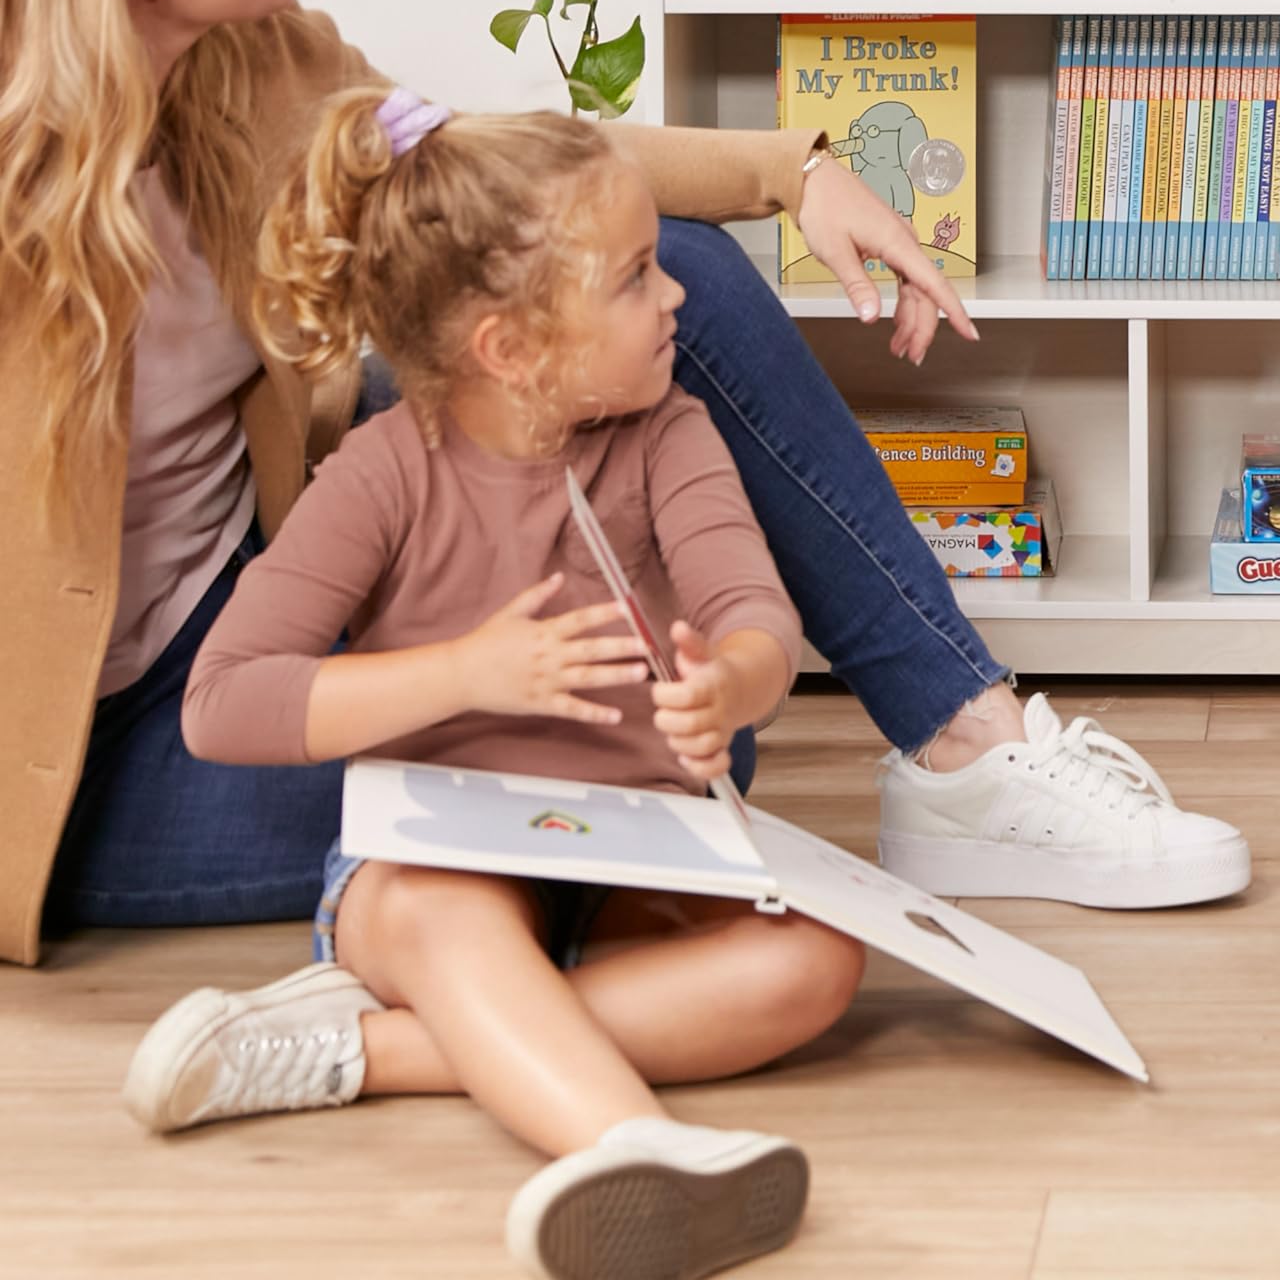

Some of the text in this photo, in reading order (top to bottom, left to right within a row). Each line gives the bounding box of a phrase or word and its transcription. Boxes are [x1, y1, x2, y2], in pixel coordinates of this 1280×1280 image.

[821, 35, 937, 61] I Broke
[796, 66, 960, 99] My Trunk!
[1056, 113, 1066, 142] LOVE
[1084, 114, 1092, 130] WE
[1122, 124, 1131, 143] CAN
[1175, 111, 1184, 136] LET'S
[1055, 145, 1064, 161] MY
[1083, 131, 1091, 153] ARE
[1174, 137, 1182, 150] GO
[1187, 139, 1195, 154] AM
[1082, 155, 1090, 164] IN
[1107, 123, 1119, 198] HAPPY PIG DAY!
[1120, 150, 1130, 173] PLAY
[1158, 109, 1171, 213] THE THANK YOU BOOK
[1173, 152, 1182, 169] FOR
[1259, 108, 1274, 214] WAITING IS NOT EASY!
[1054, 163, 1063, 188] NEW
[1185, 156, 1194, 189] GOING!
[1080, 176, 1089, 206] BOOK!
[1119, 176, 1129, 198] TOO?
[1171, 179, 1180, 209] DRIVE!
[1272, 184, 1280, 207] NAP!
[1052, 192, 1061, 218] TOY!
[874, 446, 985, 467] tence Building
[929, 539, 976, 549] MAGNA
